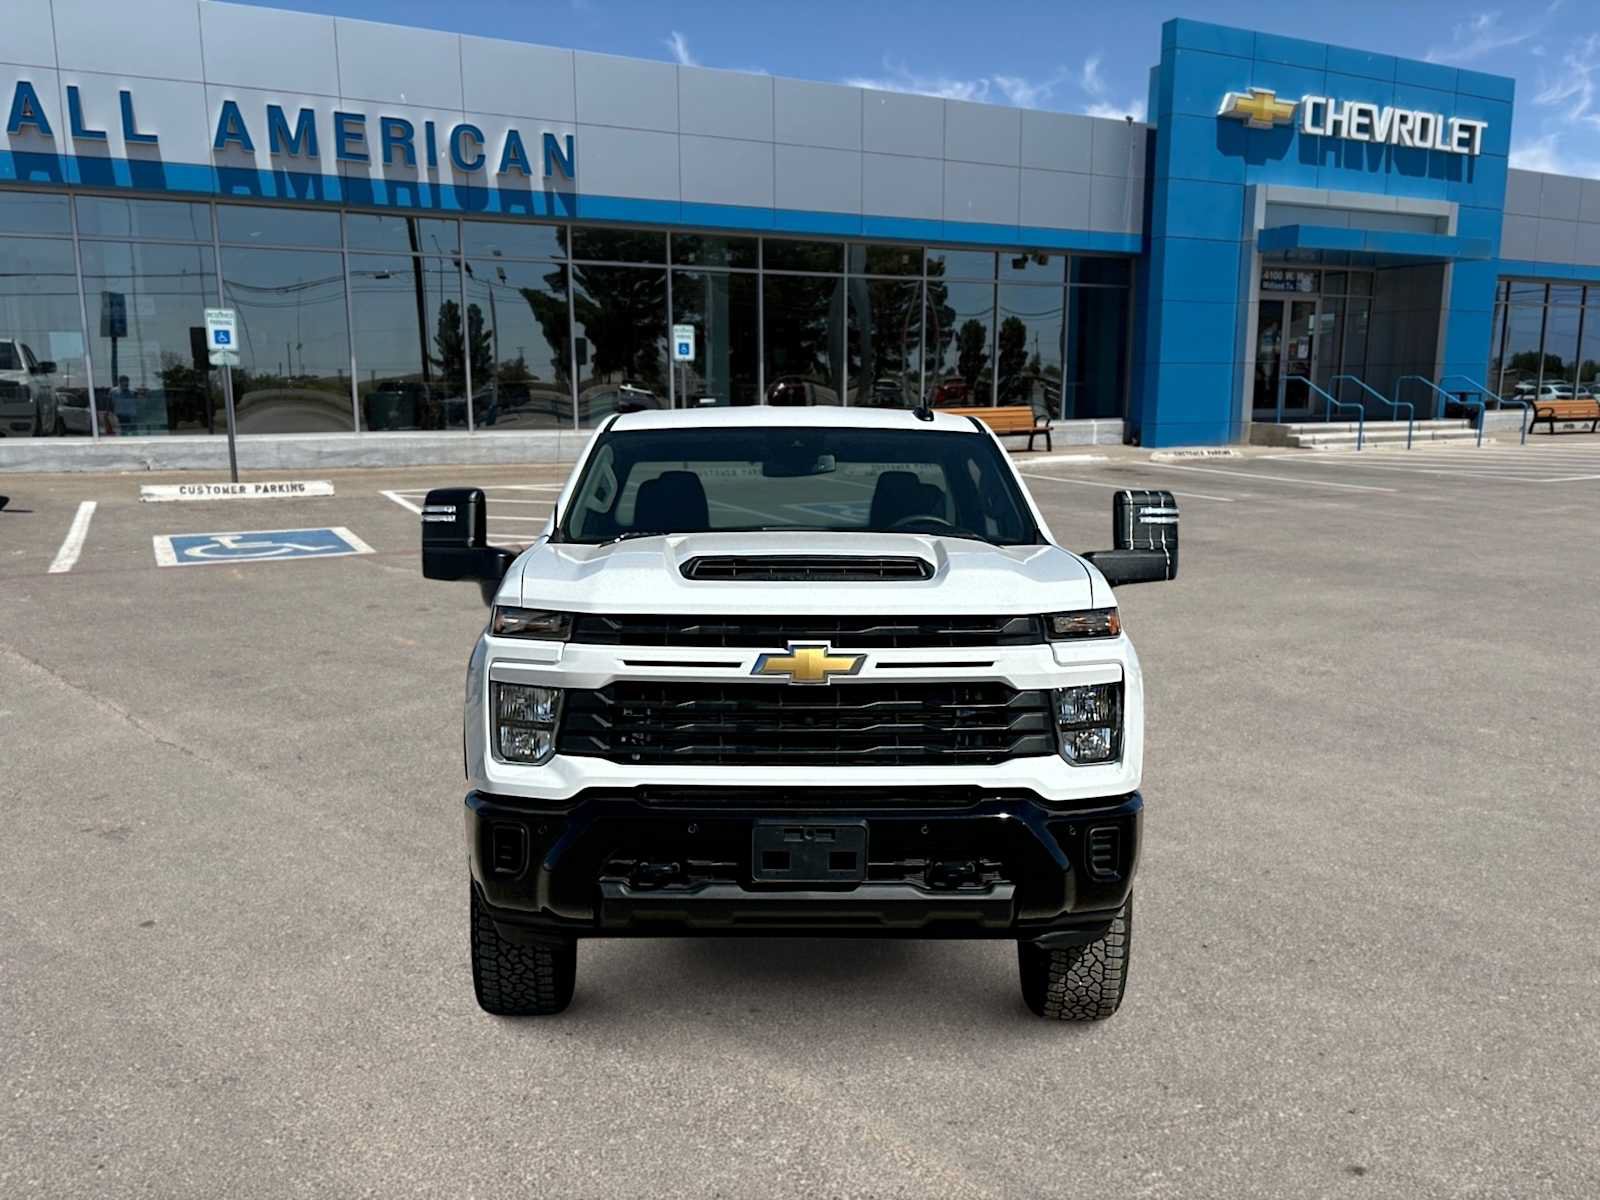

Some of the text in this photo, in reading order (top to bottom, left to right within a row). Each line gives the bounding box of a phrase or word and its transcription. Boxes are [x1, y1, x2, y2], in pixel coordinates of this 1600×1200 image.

[7, 80, 575, 179] ALL AMERICAN
[1301, 95, 1488, 155] CHEVROLET
[179, 483, 305, 495] CUSTOMER PARKING
